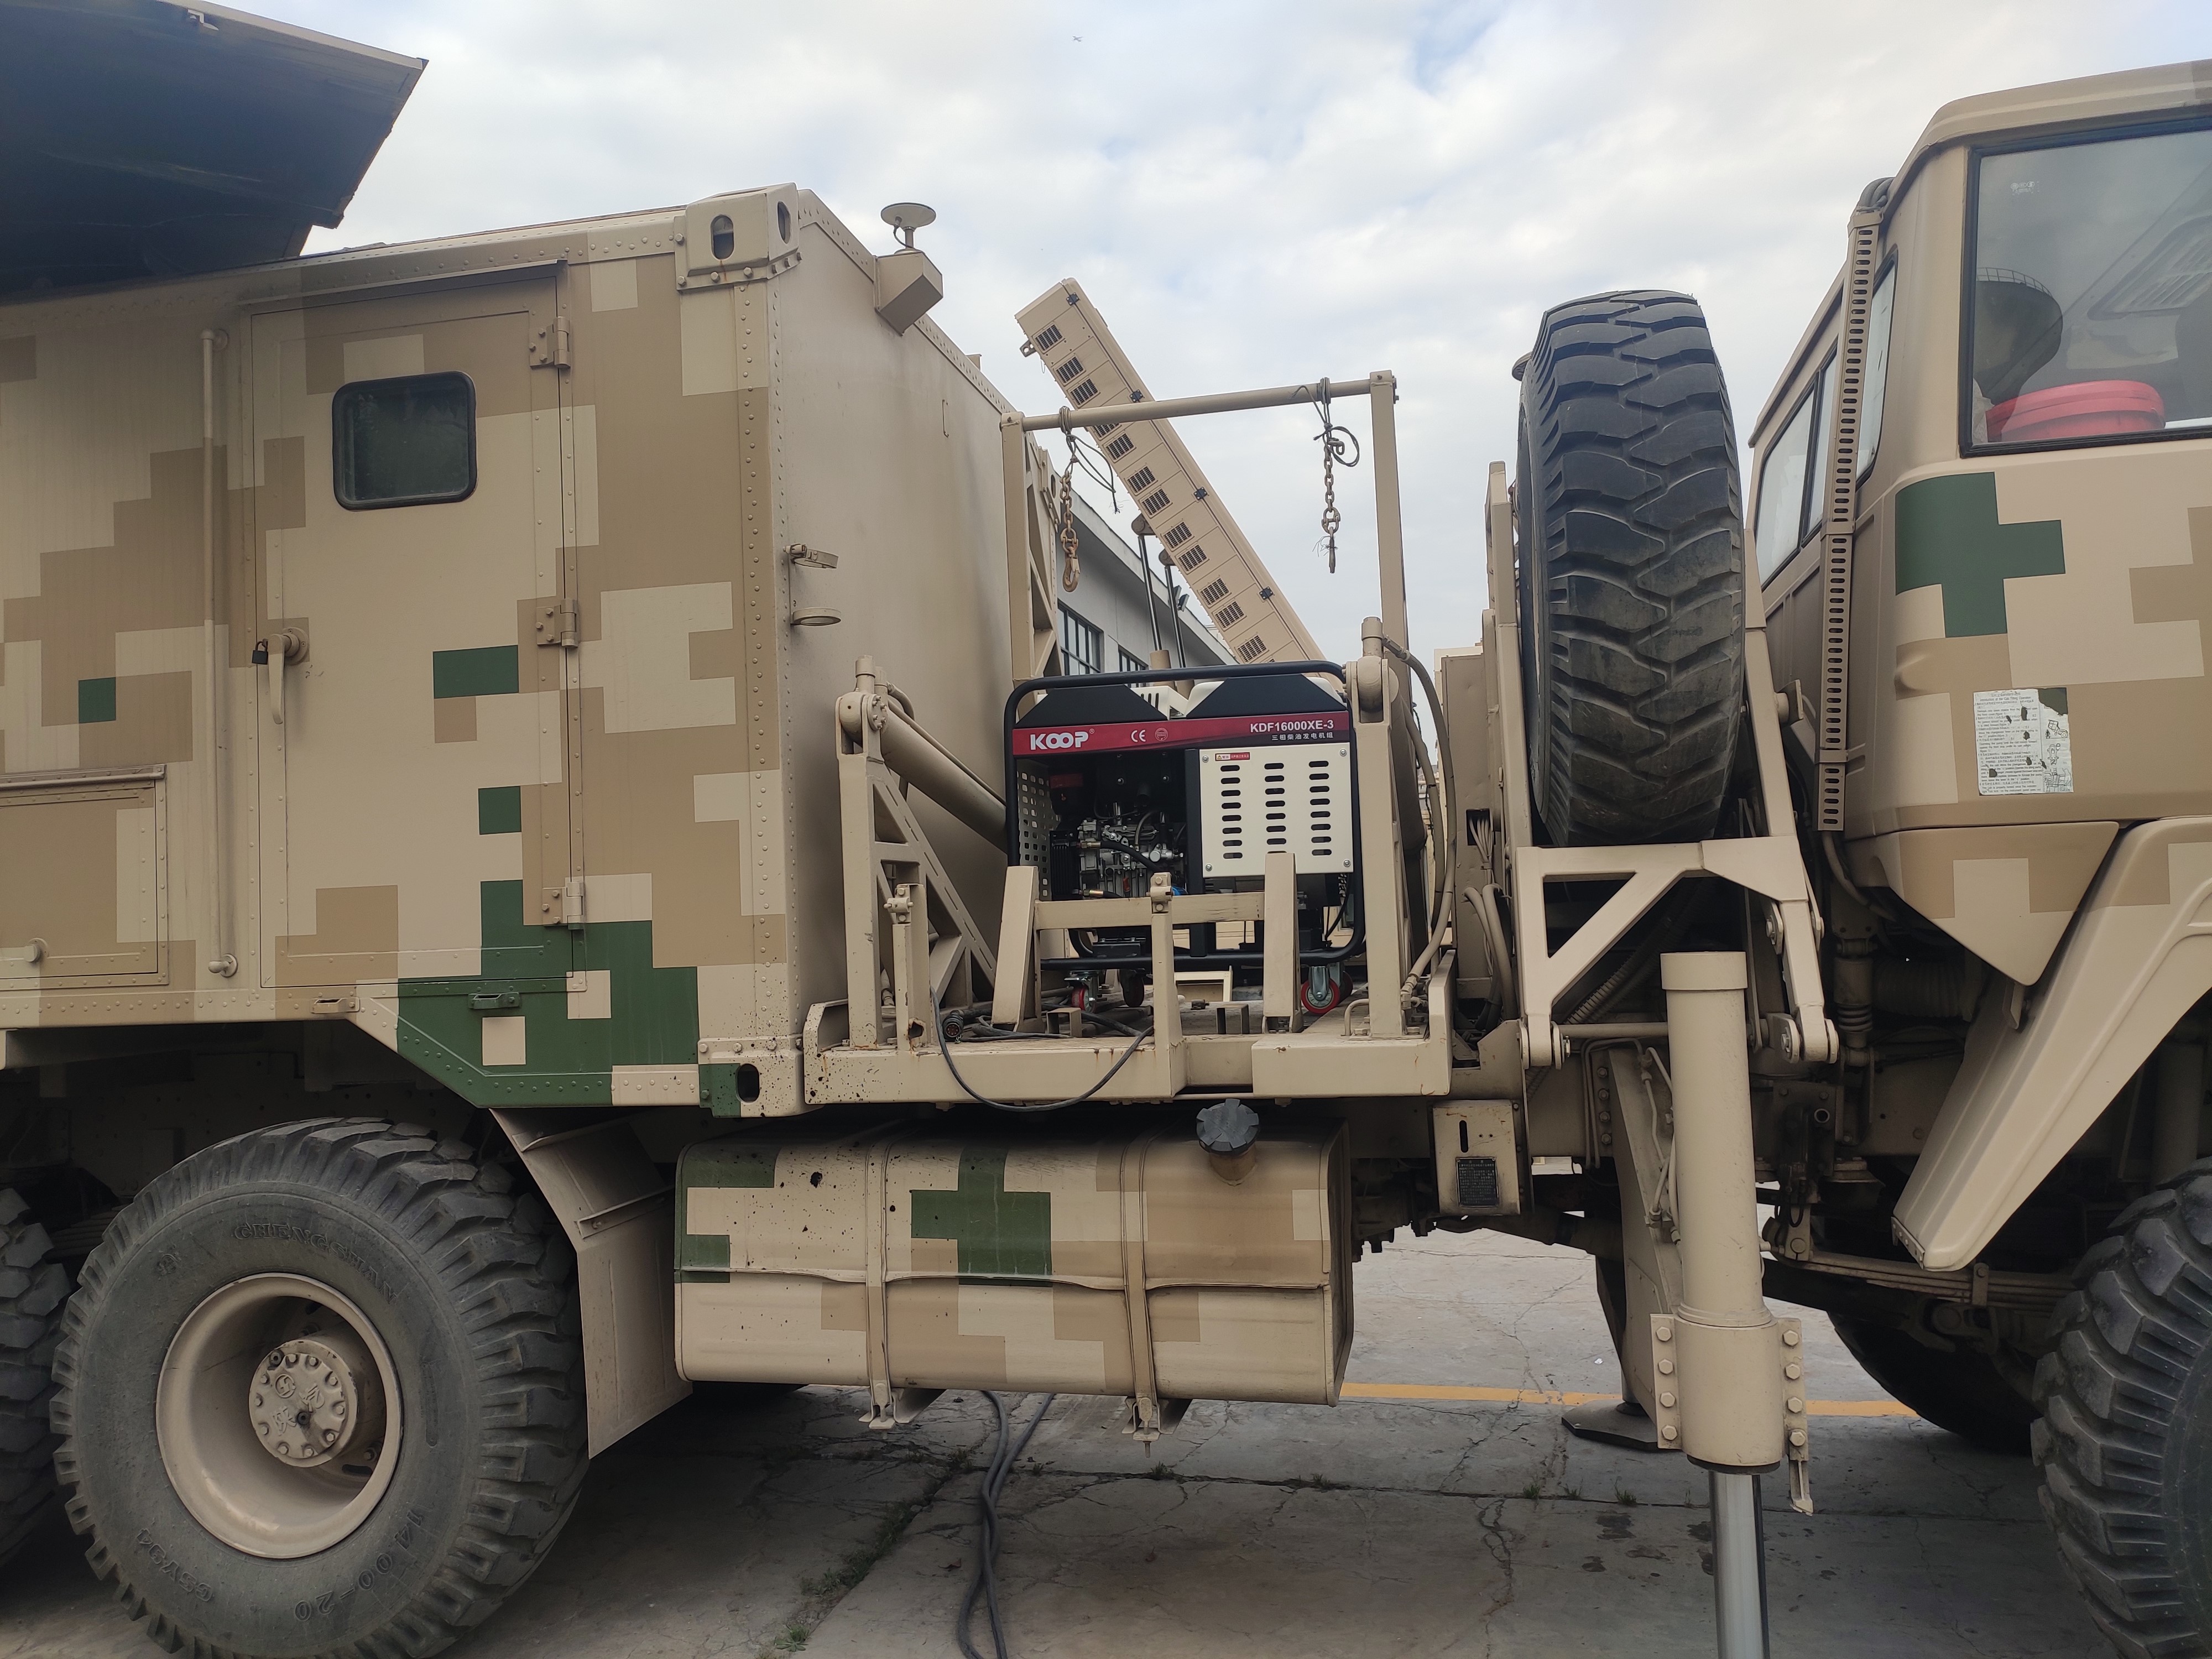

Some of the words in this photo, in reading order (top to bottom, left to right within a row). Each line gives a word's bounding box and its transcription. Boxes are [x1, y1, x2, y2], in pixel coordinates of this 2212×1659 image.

[1250, 719, 1334, 733] KDF16000XE-3
[1030, 731, 1089, 750] KOOP
[1131, 729, 1146, 743] CE
[1271, 732, 1333, 741] 三相柴油发电机组
[234, 1222, 398, 1305] CHENGSHAN
